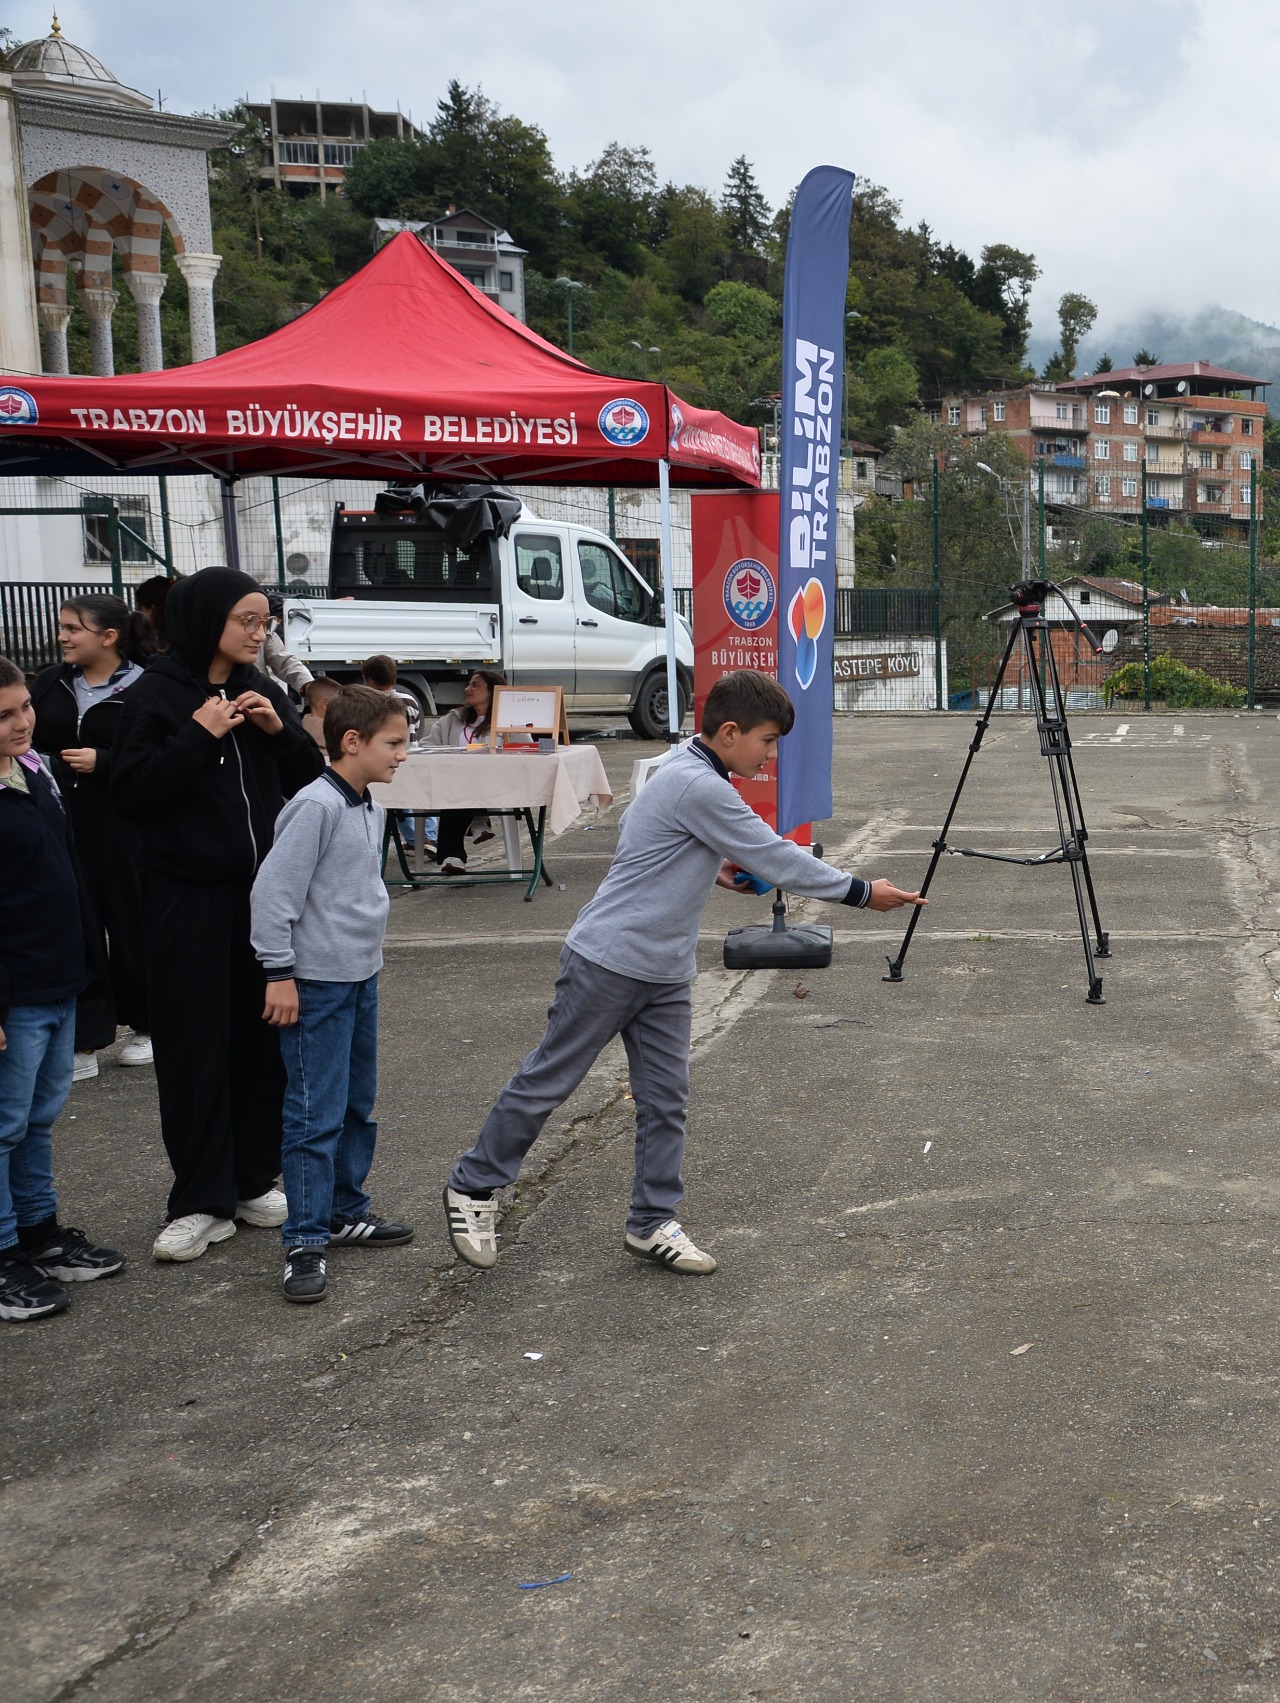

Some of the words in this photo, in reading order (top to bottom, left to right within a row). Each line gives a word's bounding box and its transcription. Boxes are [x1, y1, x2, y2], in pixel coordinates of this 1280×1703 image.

[70, 408, 207, 434] TRABZON
[226, 404, 402, 445] BÜYÜKŞEHİR
[423, 410, 578, 445] BELEDİYESİ
[811, 348, 835, 569] TRABZON
[728, 636, 773, 647] TRABZON
[711, 648, 779, 669] BÜYÜKŞEHİ
[887, 654, 919, 673] KÖYÜ
